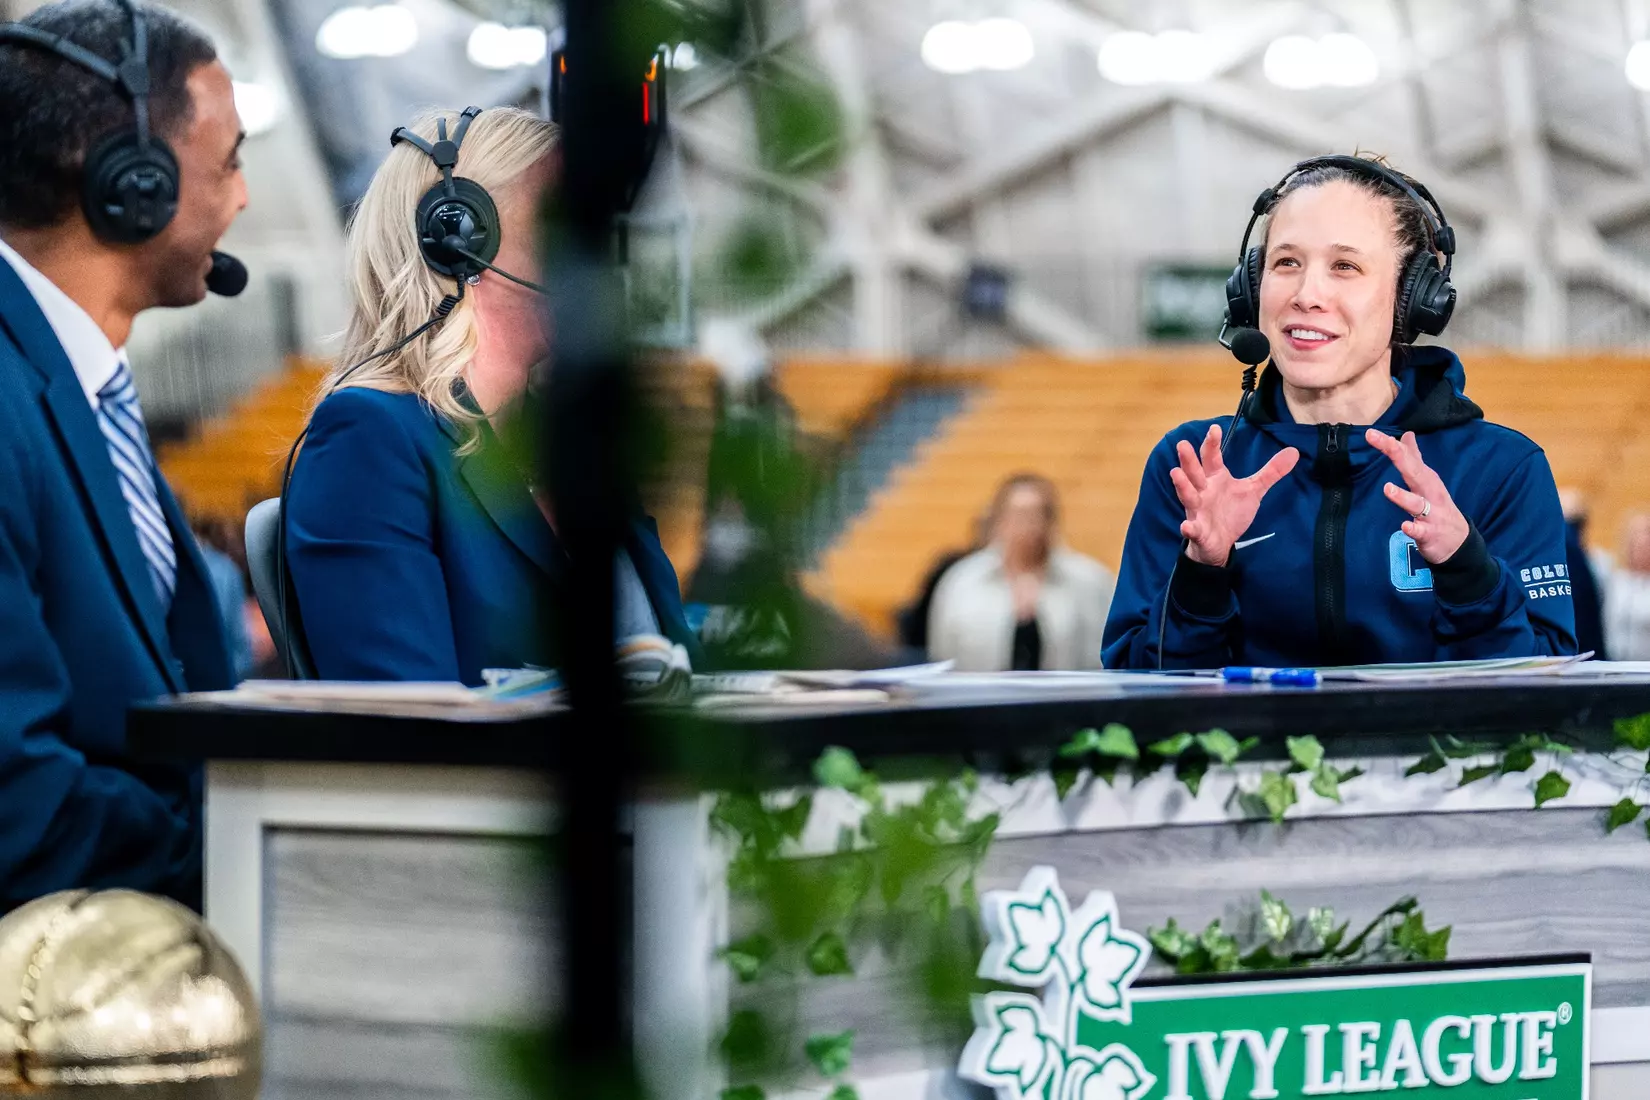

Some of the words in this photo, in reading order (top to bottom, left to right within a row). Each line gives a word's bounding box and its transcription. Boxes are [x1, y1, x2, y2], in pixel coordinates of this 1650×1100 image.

[1389, 530, 1433, 592] C
[1520, 564, 1570, 582] COLU
[1164, 1027, 1289, 1100] IVY
